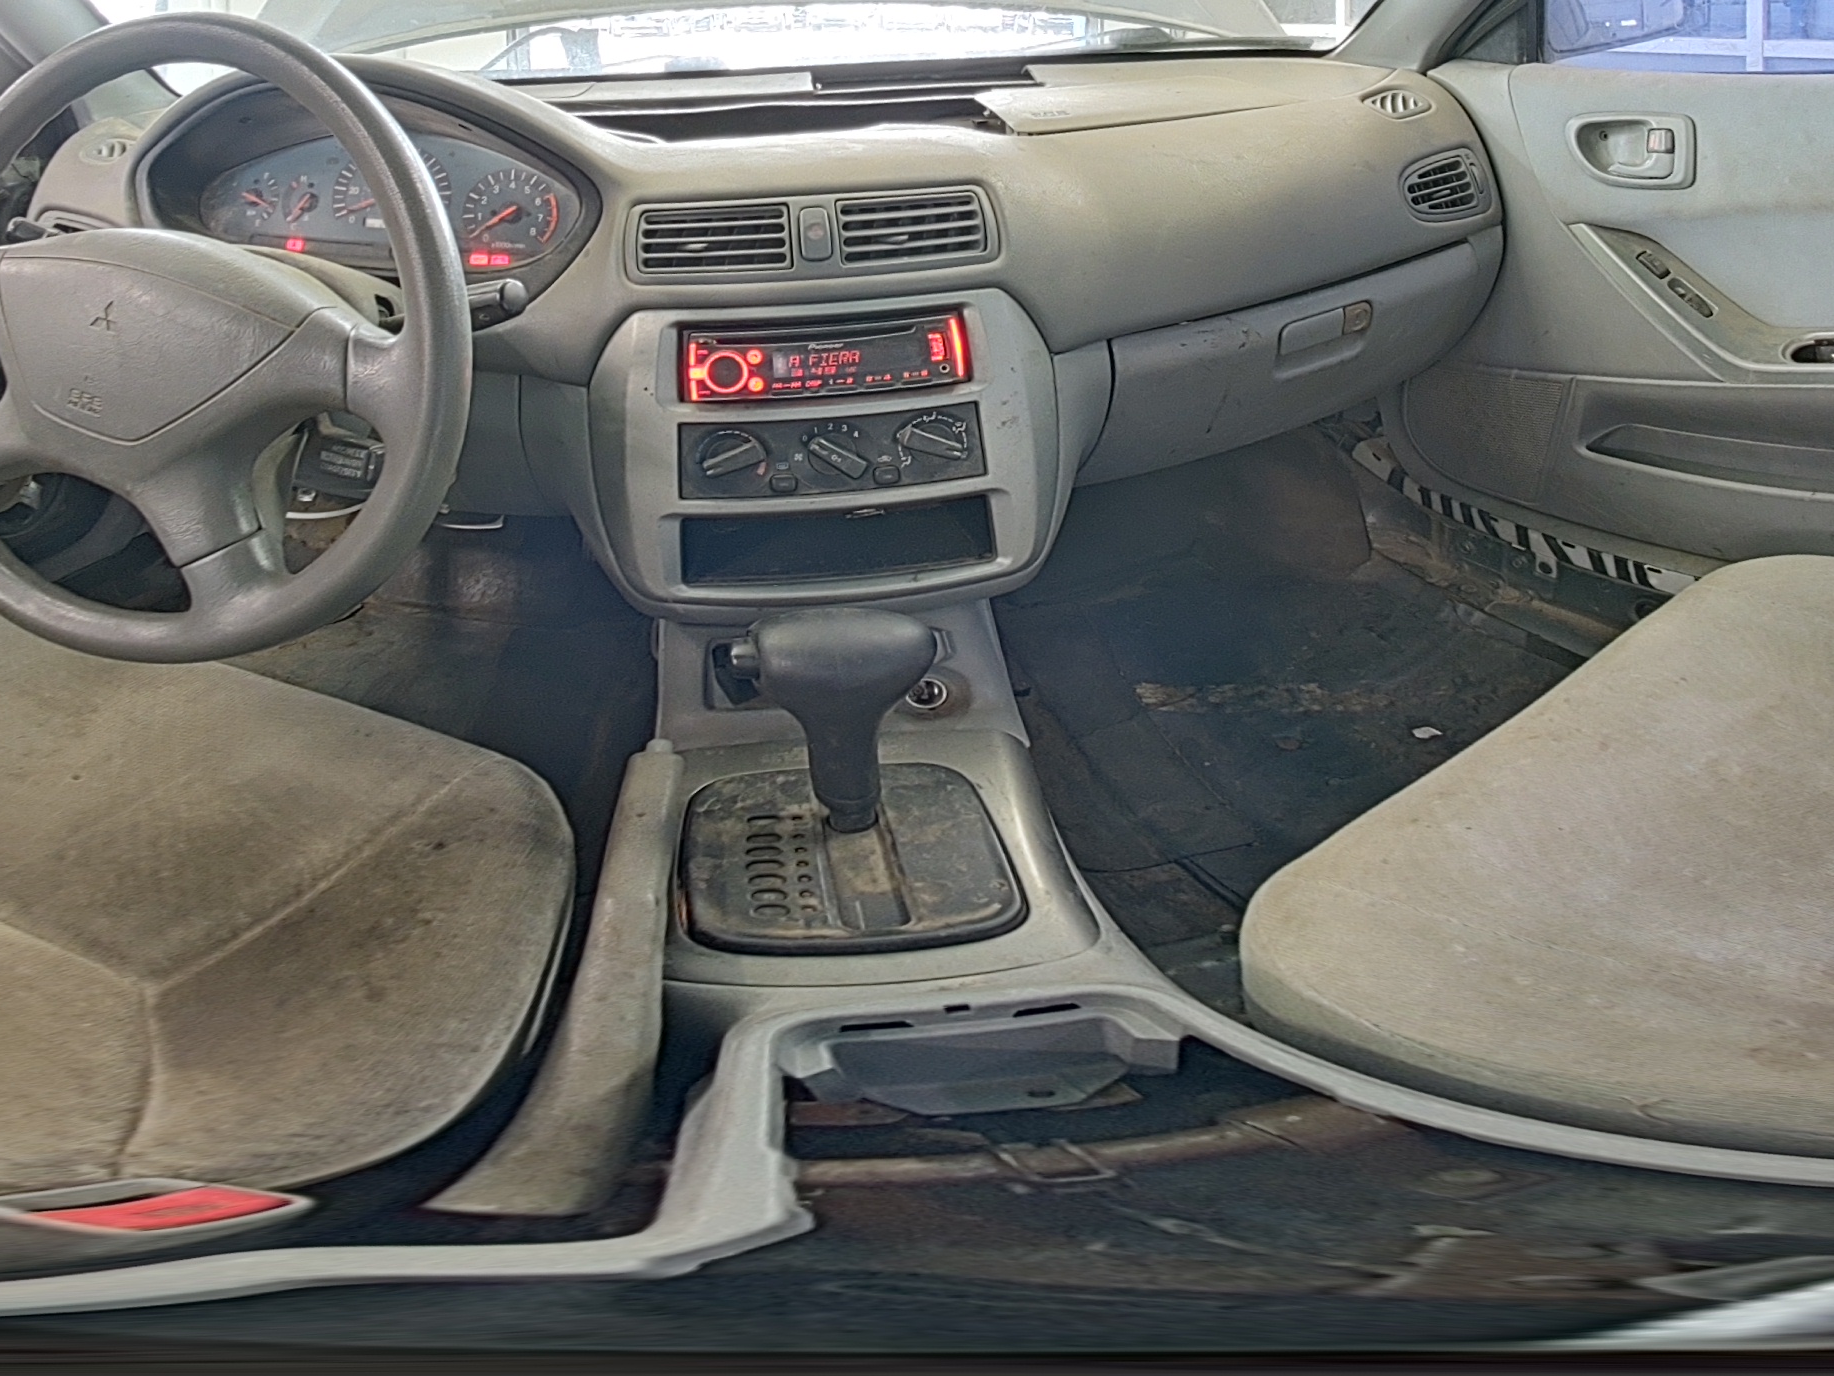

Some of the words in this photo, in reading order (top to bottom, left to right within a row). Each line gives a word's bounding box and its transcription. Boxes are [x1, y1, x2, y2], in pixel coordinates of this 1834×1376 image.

[493, 186, 499, 194] 3
[524, 186, 531, 194] 5
[481, 196, 487, 204] 2
[535, 197, 541, 206] 6
[348, 216, 355, 224] 0
[477, 212, 482, 220] 1
[537, 214, 544, 222] 7
[530, 228, 536, 236] 8
[482, 234, 489, 242] 0
[809, 351, 861, 367] FIERA
[842, 424, 848, 432] 3
